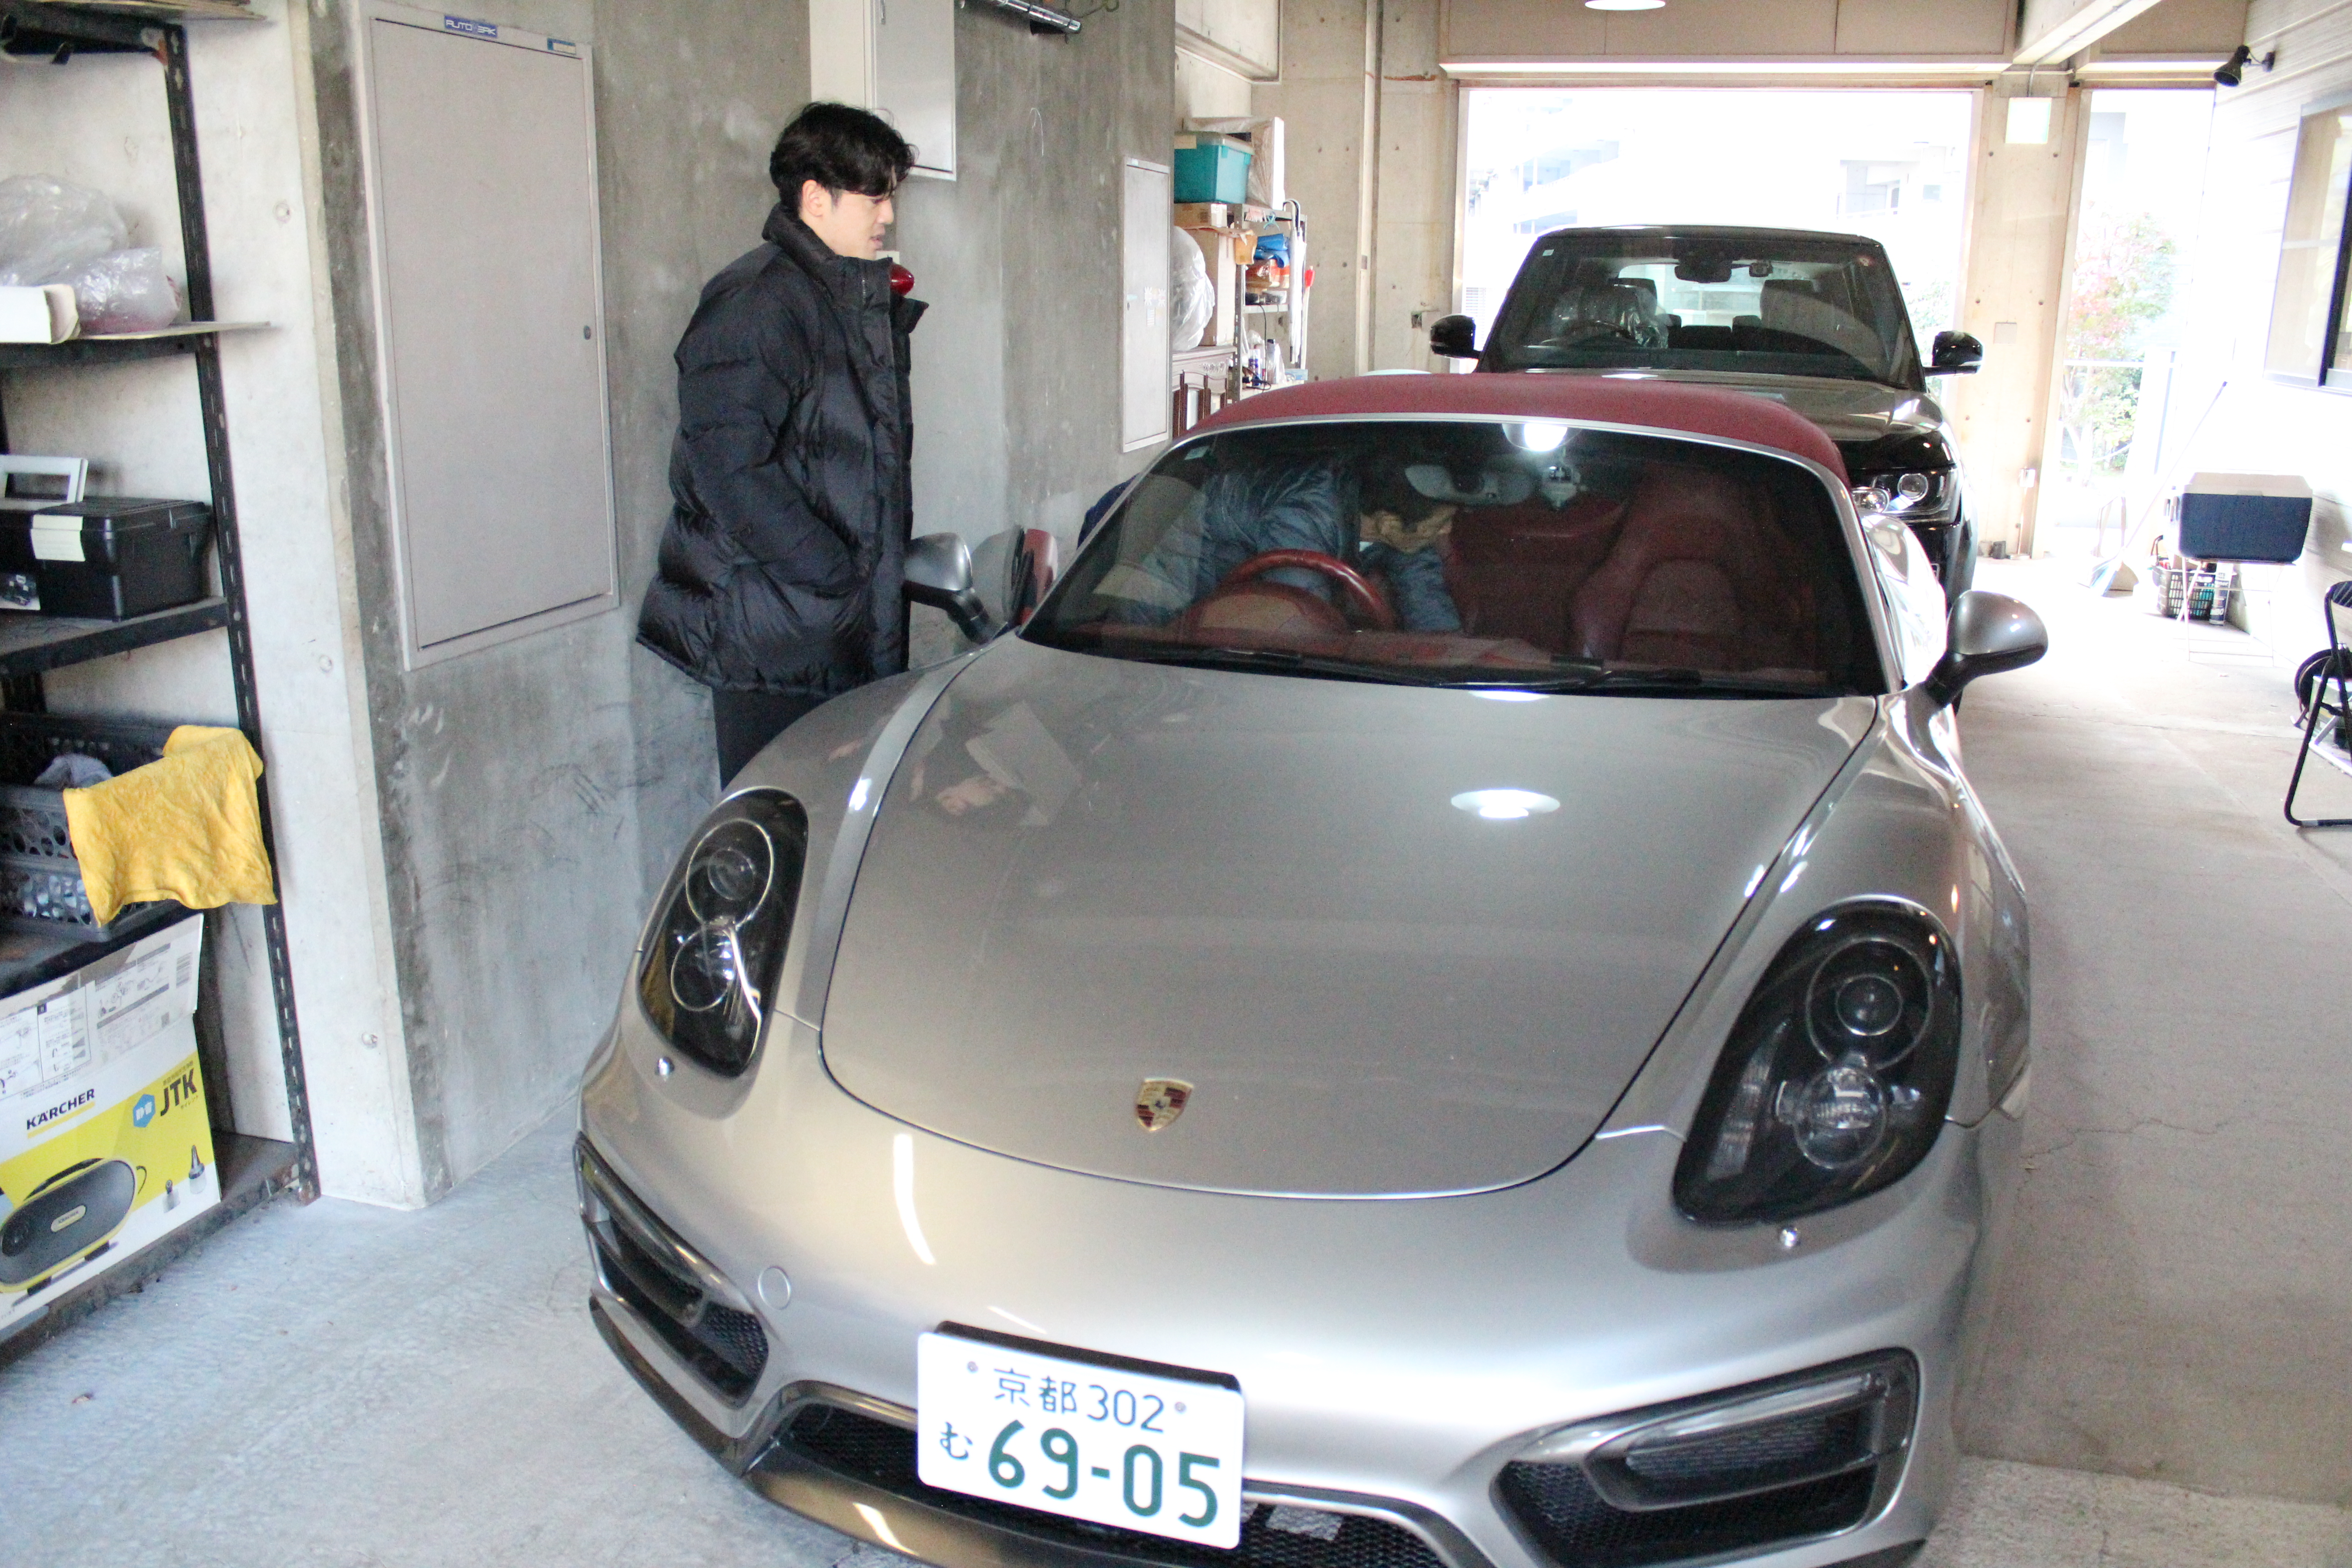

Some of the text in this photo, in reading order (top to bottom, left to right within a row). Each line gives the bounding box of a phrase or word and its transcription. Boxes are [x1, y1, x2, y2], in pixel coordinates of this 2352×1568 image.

[27, 1088, 95, 1130] KÄRCHER
[160, 1068, 197, 1116] JTK
[1087, 1384, 1164, 1433] 302
[940, 1419, 1220, 1527] む 69-05
